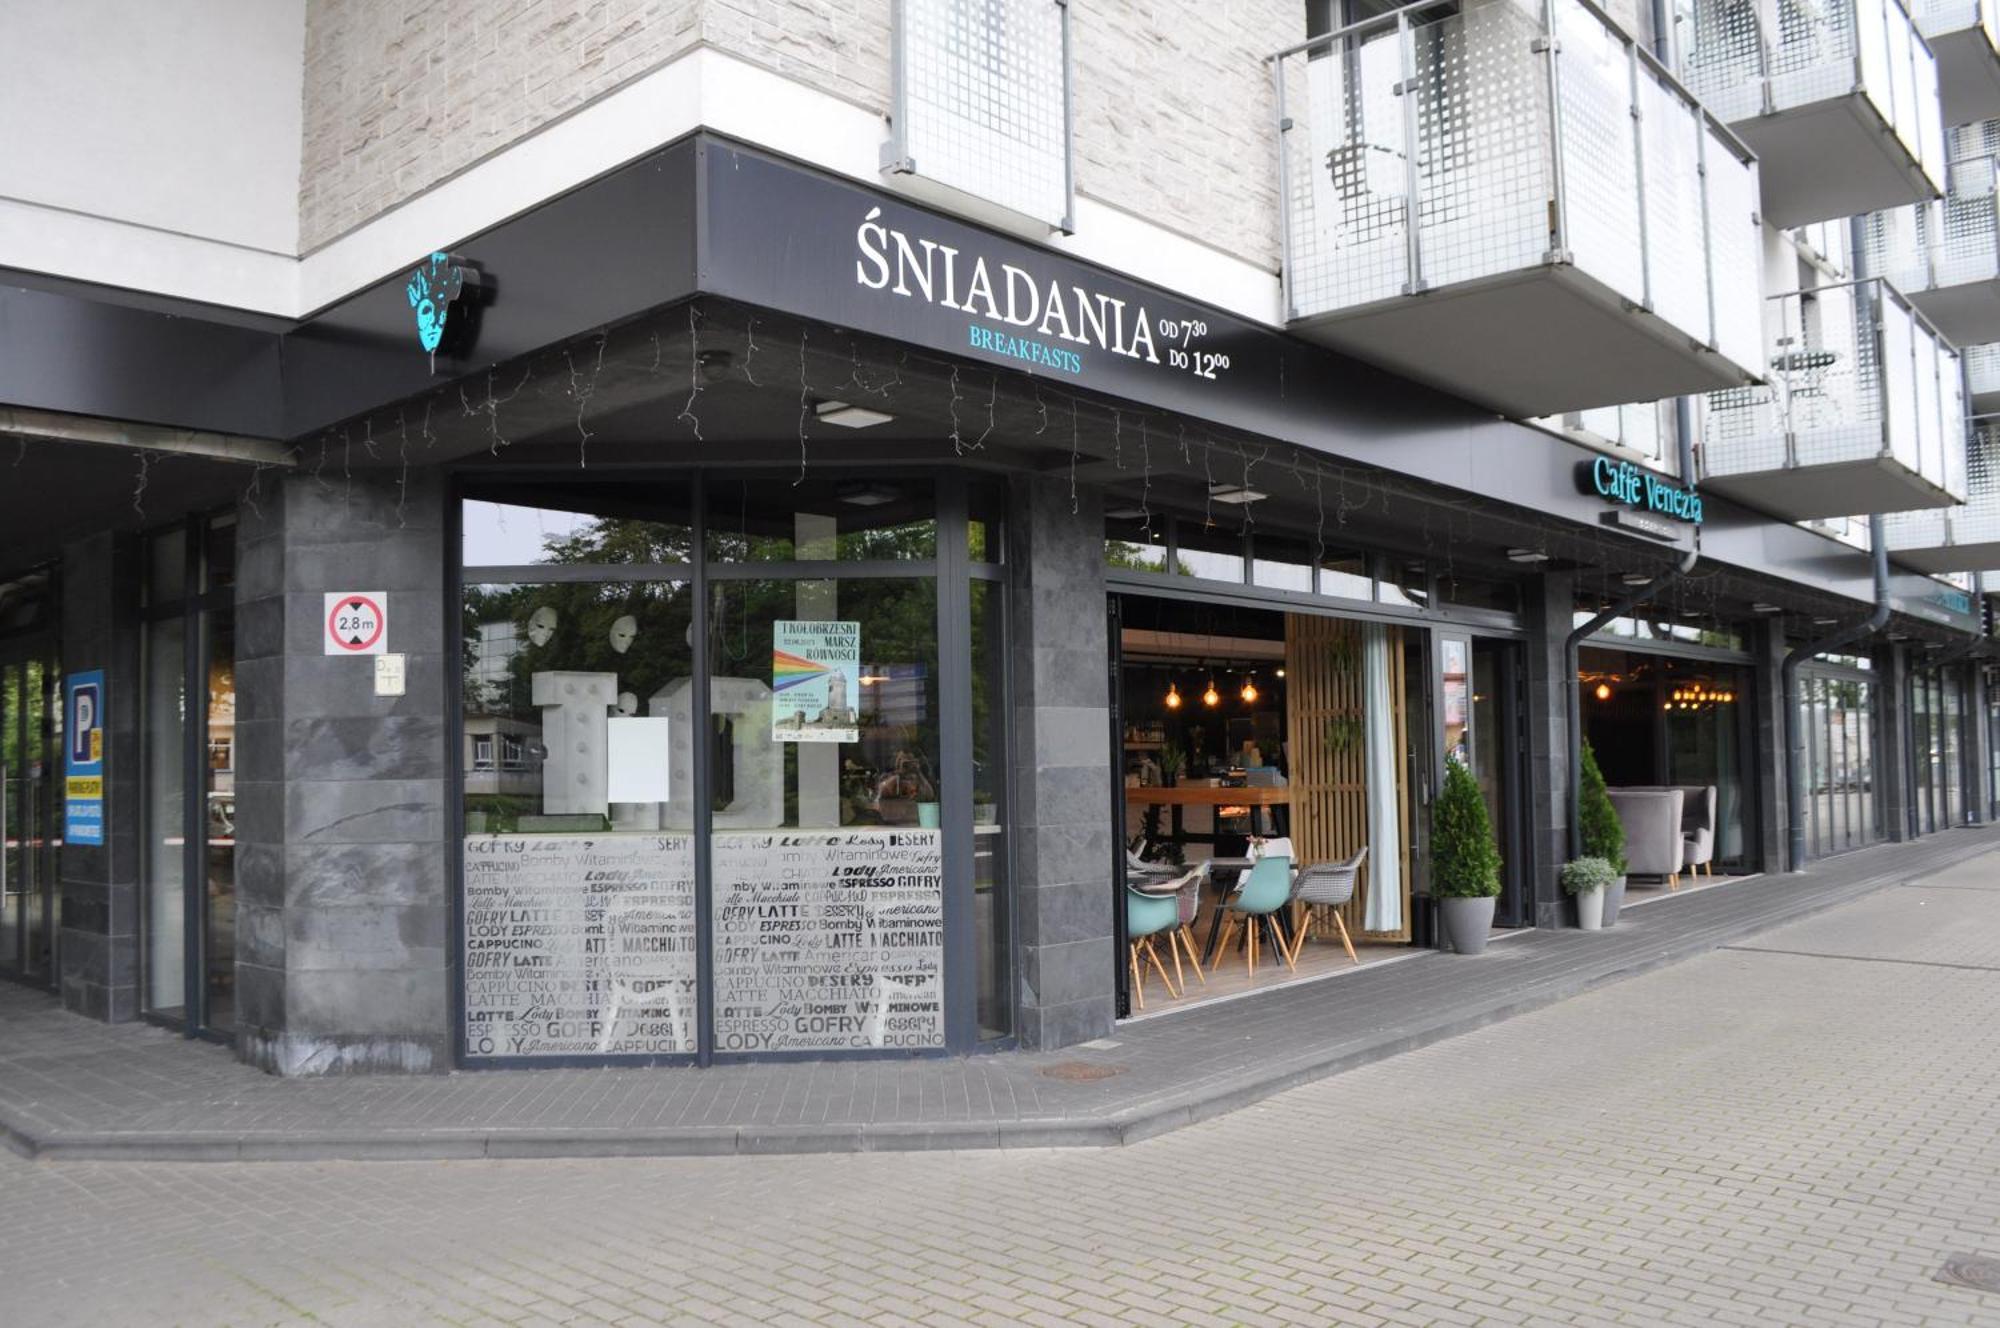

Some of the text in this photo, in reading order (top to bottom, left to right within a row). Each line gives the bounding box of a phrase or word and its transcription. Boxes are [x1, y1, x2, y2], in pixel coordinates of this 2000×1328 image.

[857, 206, 1160, 365] ŚNIADANIA
[1159, 318, 1179, 339] OD
[969, 326, 1082, 375] BREAKFASTS
[1169, 349, 1189, 369] DO
[1644, 474, 1703, 524] Venezia
[362, 621, 374, 629] m
[824, 636, 857, 647] MARSZ
[77, 695, 93, 753] P
[832, 865, 877, 878] Lody
[839, 877, 896, 889] ESPRESSO
[466, 886, 510, 898] Bomby
[758, 905, 809, 918] LATTE
[469, 925, 507, 937] LODY
[760, 920, 817, 932] ESPRESSO
[819, 918, 863, 933] Bomby
[467, 939, 543, 949] CAPPUCINO
[825, 932, 863, 948] LATTE
[467, 951, 511, 968] GOFRY
[514, 955, 553, 967] LATTE
[466, 981, 557, 993] CAPPUCINO
[632, 980, 696, 994] GOFY
[779, 987, 881, 1002] MACCHIATO
[468, 993, 520, 1006] LATTE
[468, 1011, 514, 1022] LATTE
[518, 1005, 553, 1024] Lody
[766, 1000, 802, 1020] Lody
[468, 1023, 541, 1037] ESPESSO
[716, 1019, 789, 1033] ESPRESSO
[794, 1016, 867, 1034] GOFRY
[714, 1033, 945, 1051] LODY Americano CAPUCINO
